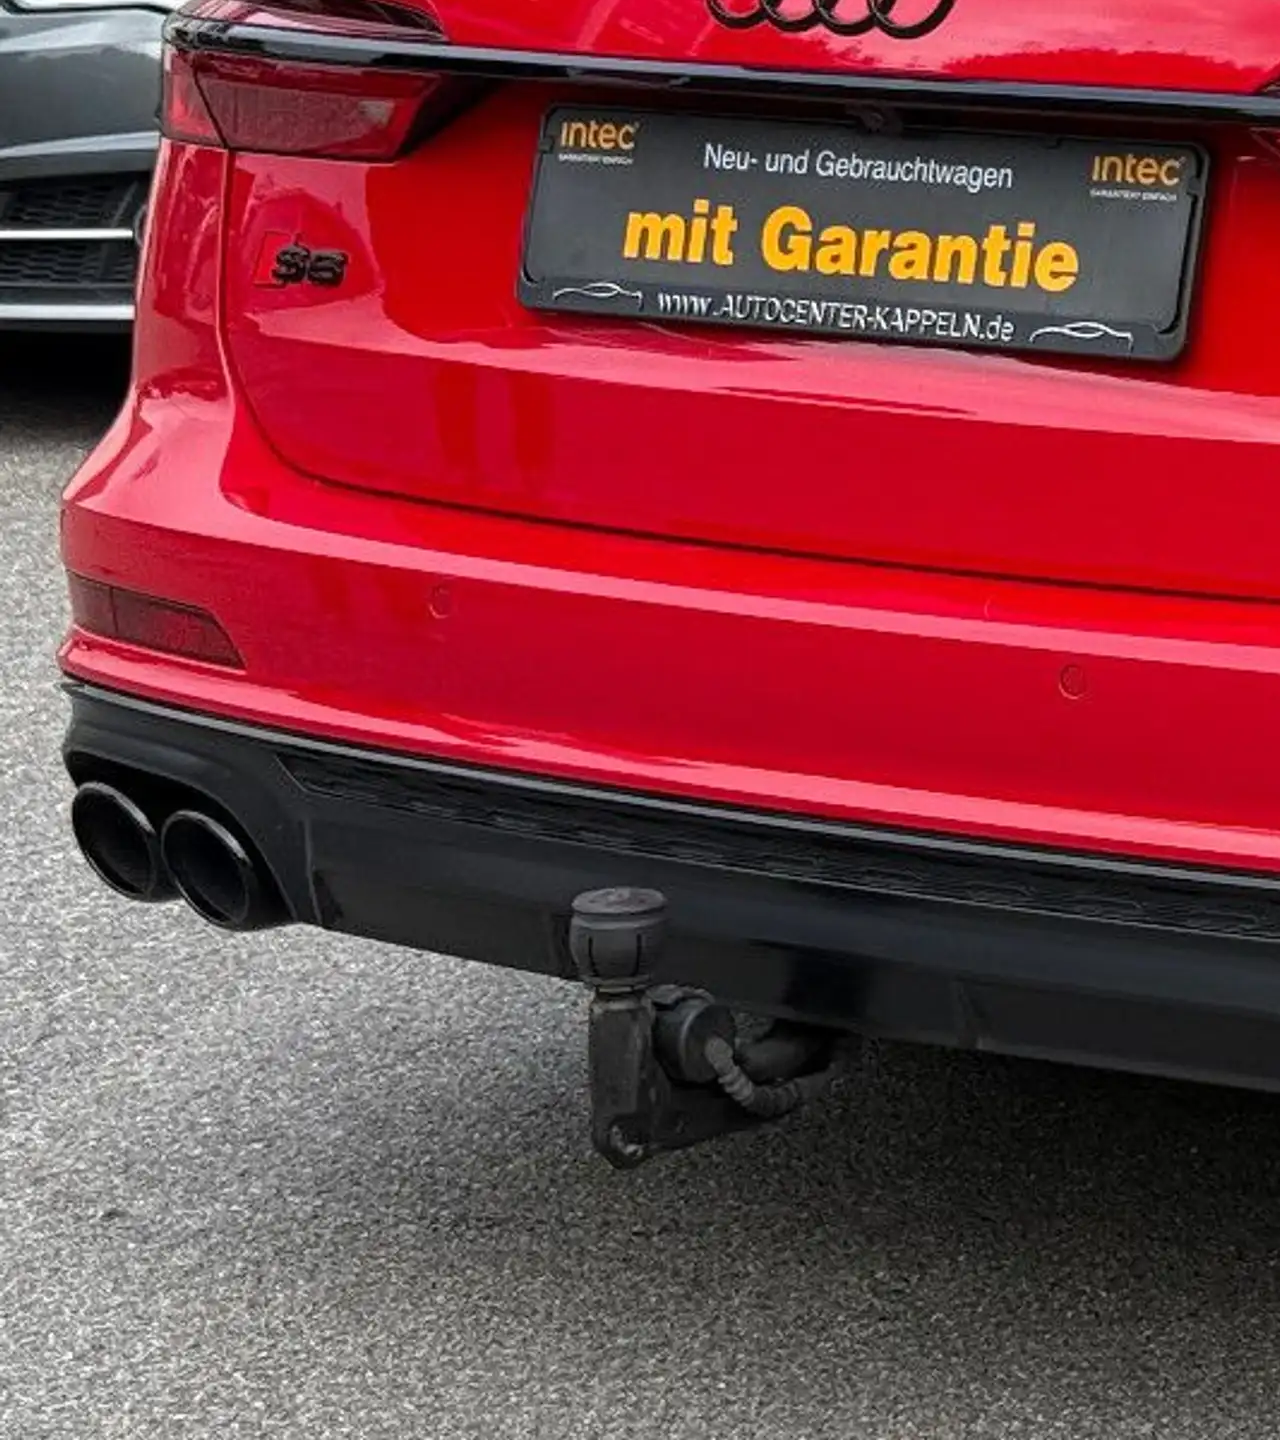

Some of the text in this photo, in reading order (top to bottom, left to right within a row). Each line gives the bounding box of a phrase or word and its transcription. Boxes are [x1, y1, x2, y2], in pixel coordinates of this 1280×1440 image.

[704, 143, 1013, 193] Neu- und Gebrauchtwagen
[623, 198, 1079, 292] mit Garantie
